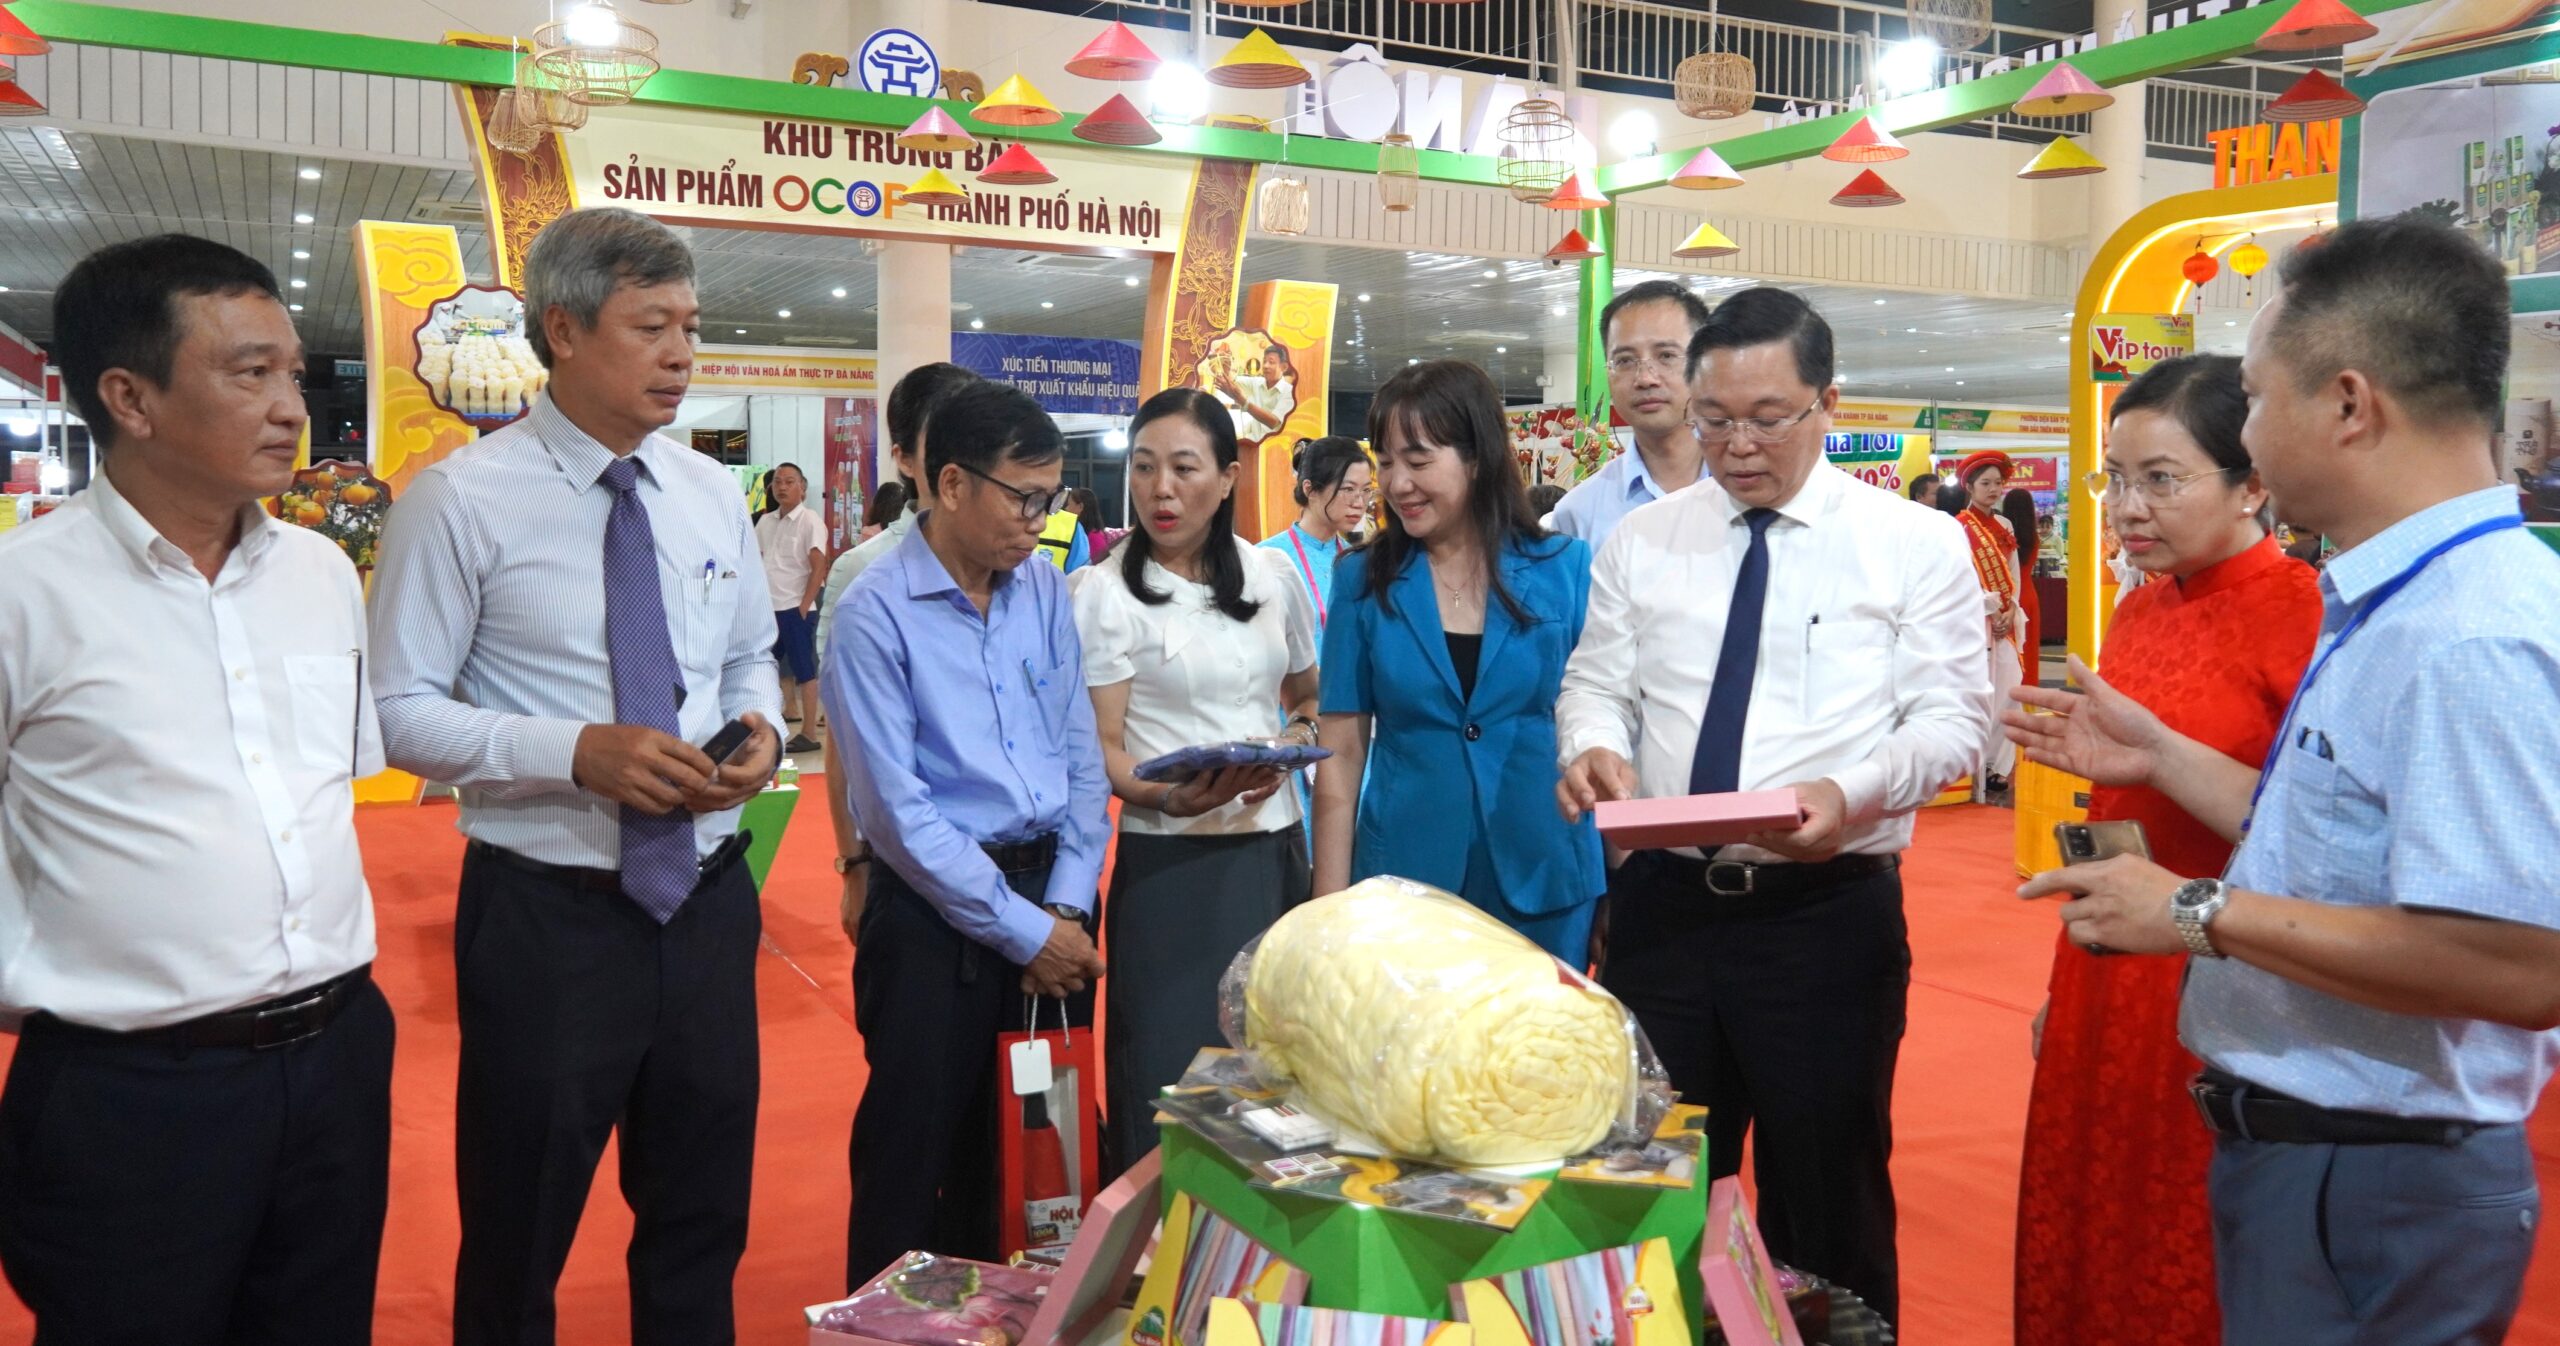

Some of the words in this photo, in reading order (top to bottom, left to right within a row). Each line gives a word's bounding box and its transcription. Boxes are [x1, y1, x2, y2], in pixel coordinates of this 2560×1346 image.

[764, 121, 833, 159] KHU
[965, 137, 1026, 172] BÀ
[603, 153, 666, 202] SẢN
[677, 158, 764, 208] PHẨM
[773, 174, 911, 220] OCOP
[1019, 189, 1070, 231] PHỐ
[1078, 196, 1112, 235] HÀ
[1119, 200, 1161, 244] NỘI
[2096, 328, 2140, 360] Vip
[2142, 341, 2185, 361] tour
[701, 363, 722, 377] HIỆP
[725, 363, 740, 378] HỘI
[743, 364, 760, 377] VĂN
[799, 367, 821, 380] THỰC
[824, 369, 834, 379] TP
[1002, 356, 1023, 373] XÚC
[1025, 355, 1048, 374] TIẾN
[1050, 358, 1090, 375] THƯƠNG
[1092, 361, 1111, 379] MẠI
[1017, 379, 1036, 397] TRỢ
[1039, 377, 1065, 395] XUẤT
[1068, 376, 1094, 397] KHẨU
[1097, 381, 1120, 400] HIỆU
